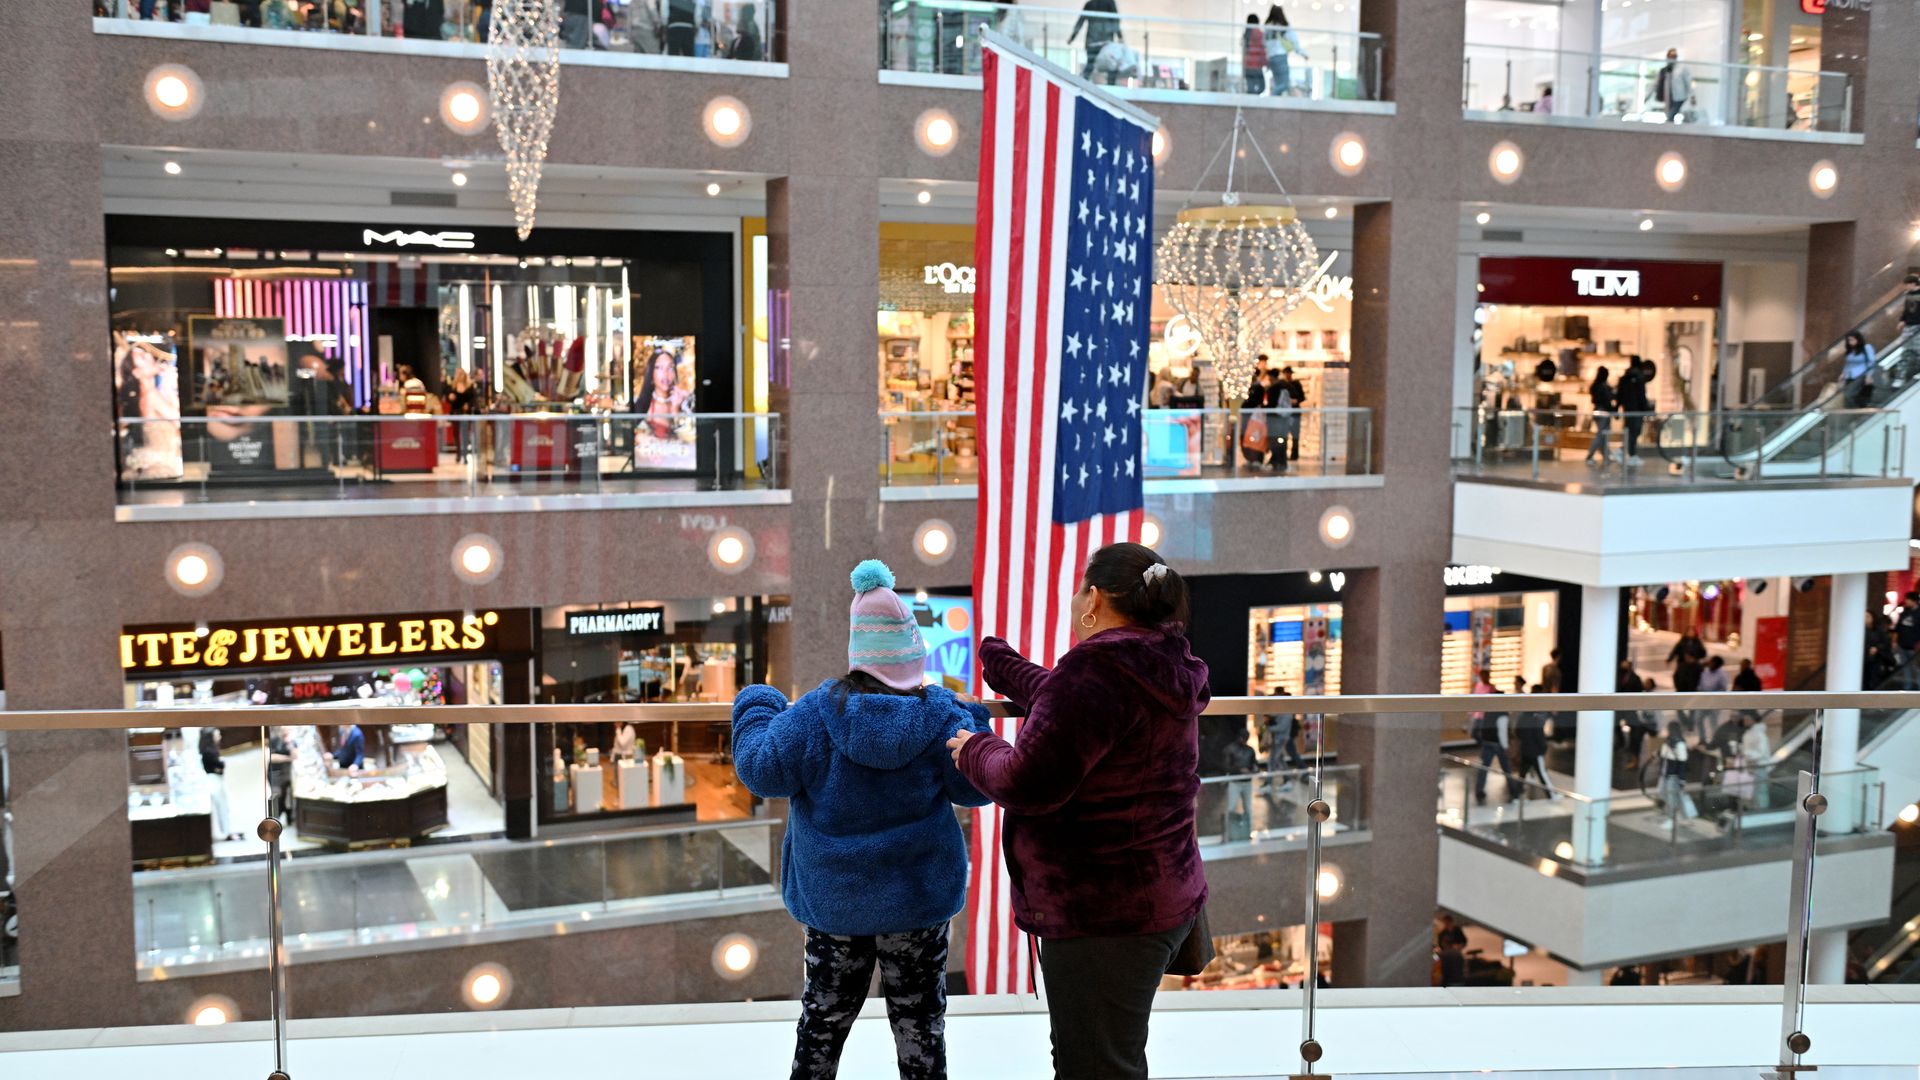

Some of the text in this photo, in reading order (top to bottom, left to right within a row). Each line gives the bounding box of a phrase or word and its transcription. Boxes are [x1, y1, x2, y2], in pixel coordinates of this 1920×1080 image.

[363, 229, 475, 249] MAC
[1571, 268, 1640, 297] TUMI
[570, 612, 660, 634] PHARMACIOPY
[119, 631, 200, 668] ITE
[239, 617, 486, 663] JEWELERS
